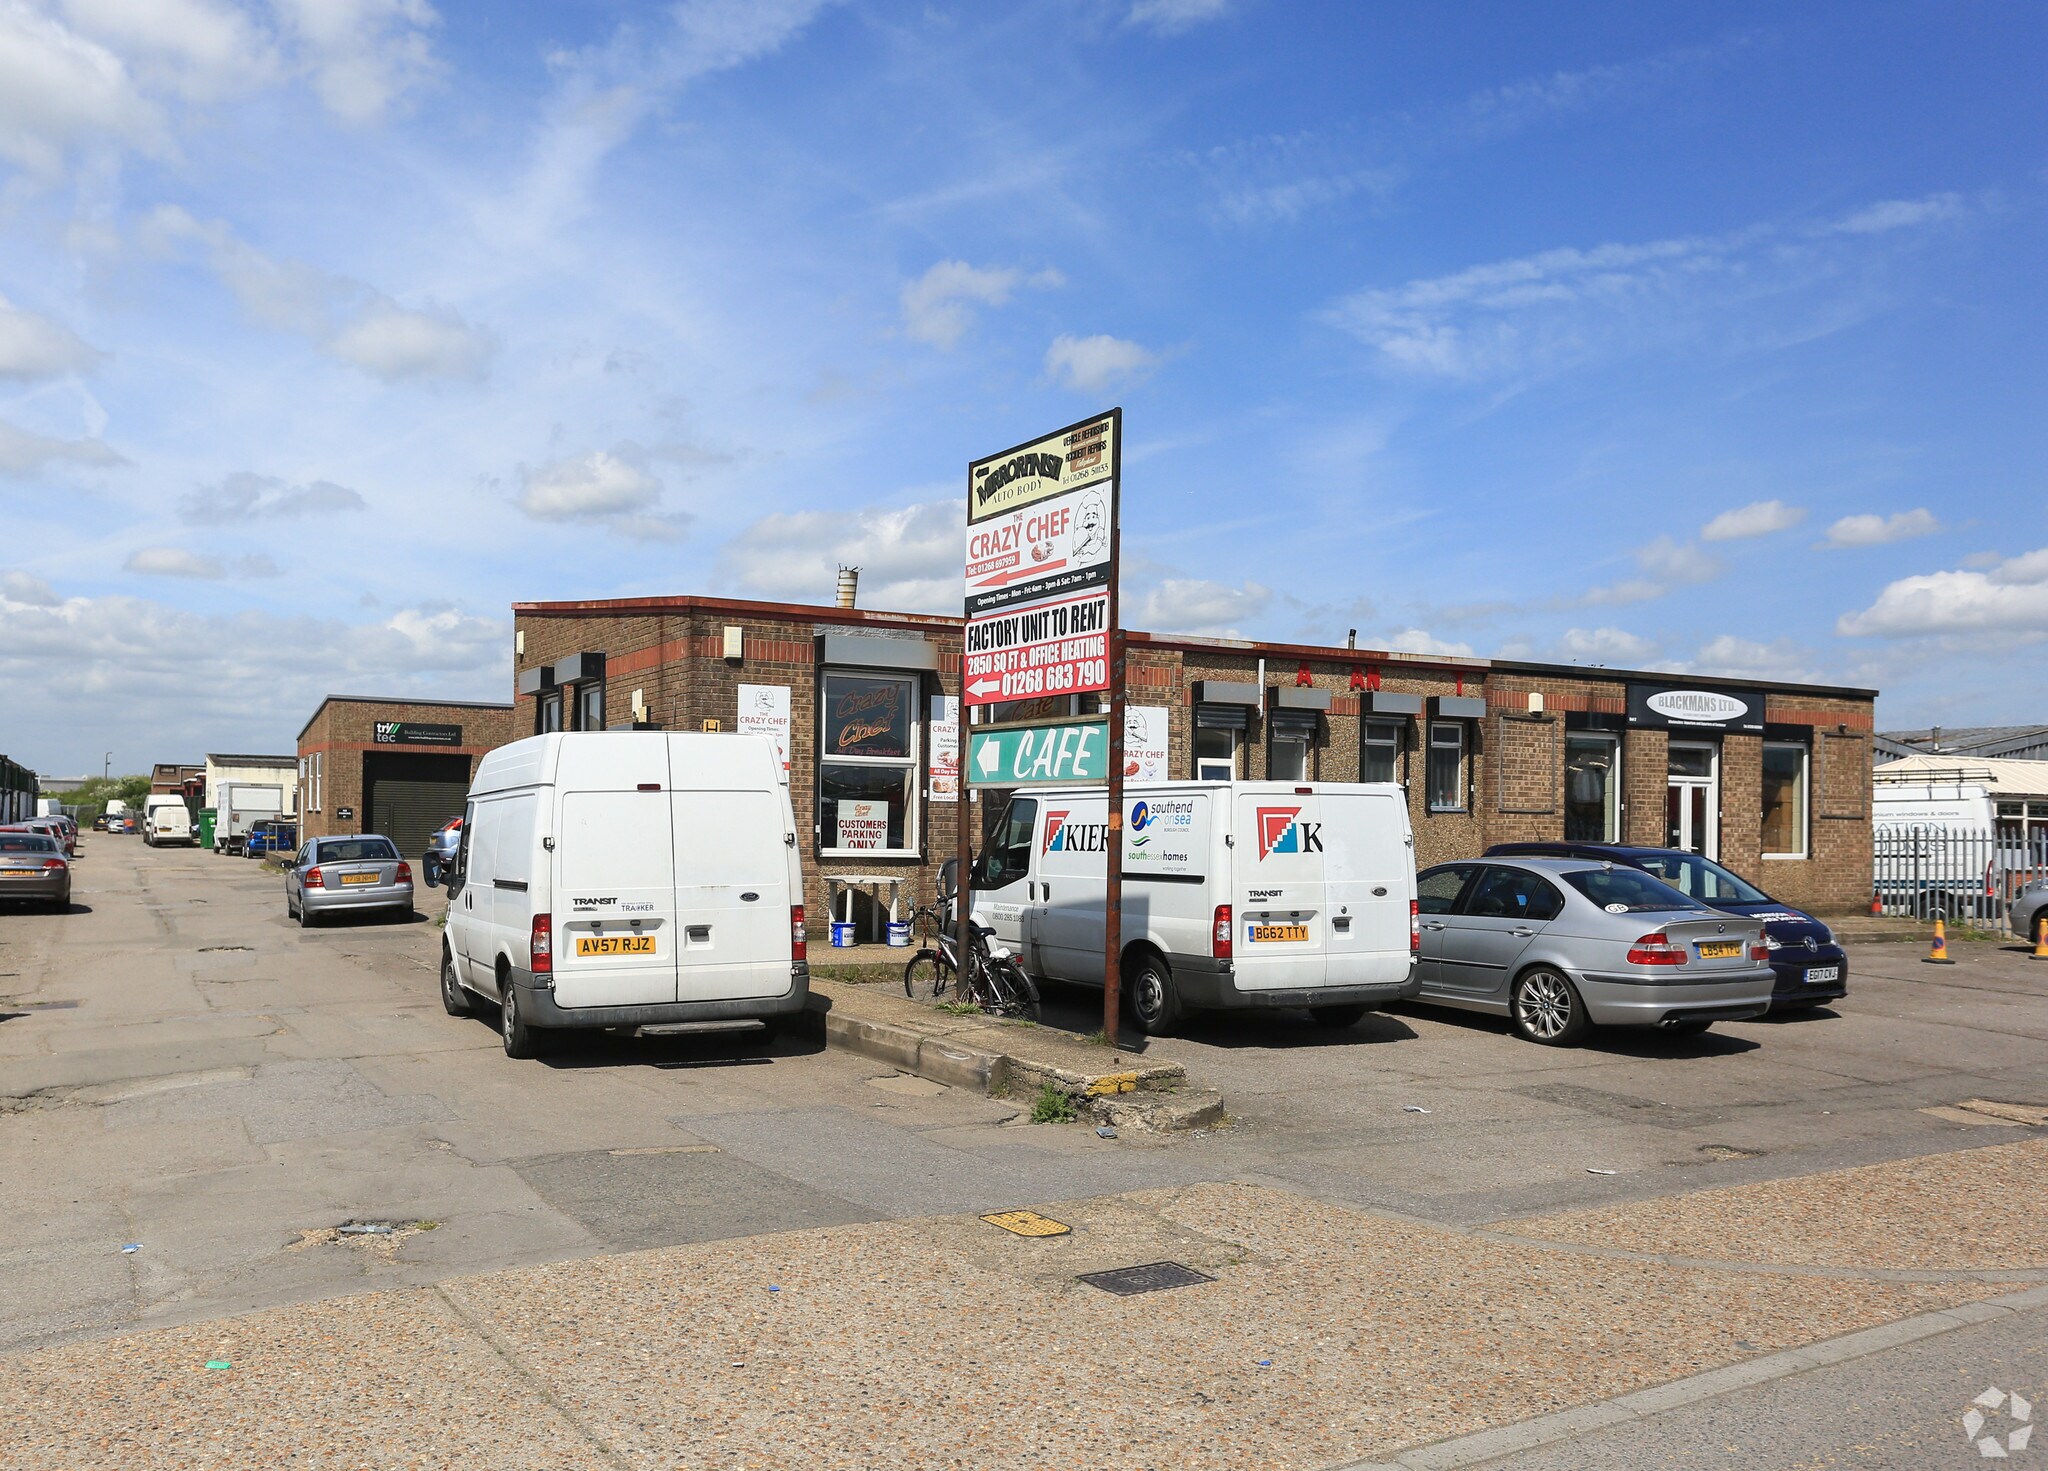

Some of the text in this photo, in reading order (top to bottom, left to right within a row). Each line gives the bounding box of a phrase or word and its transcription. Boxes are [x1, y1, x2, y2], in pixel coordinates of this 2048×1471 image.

[992, 479, 1042, 504] AUTO BODY
[1013, 512, 1023, 522] THE
[970, 507, 1070, 559] CRAZY CHEF
[978, 561, 994, 573] 01268
[977, 596, 996, 606] Opening
[996, 593, 1009, 601] Times
[1032, 584, 1042, 592] 6am
[1045, 581, 1056, 590] 3pm
[1071, 575, 1082, 583] 7am
[1085, 571, 1096, 580] 1pm
[968, 599, 1106, 652] FACTORY UNIT TO RENT
[967, 635, 1105, 676] 2850 SQ FT & OFFICE HEATING
[1001, 658, 1106, 697] 01268 683 790
[836, 683, 900, 718] Crazy
[1658, 695, 1737, 712] BLACKMANS LTD.
[740, 716, 788, 725] CRAZY CHEF
[839, 705, 899, 747] Chef
[932, 725, 956, 733] CRAZY
[377, 733, 396, 743] tec
[1013, 725, 1100, 779] CAFE
[855, 803, 872, 811] Crazy
[1150, 799, 1194, 813] southend
[838, 819, 887, 829] CUSTOMERS
[842, 830, 882, 839] PARKING
[1064, 824, 1109, 852] KIER
[1300, 823, 1323, 853] K
[848, 840, 876, 848] ONLY
[572, 897, 618, 905] TRANSIT
[993, 903, 1019, 912] Maintenance
[1609, 904, 1626, 913] GB
[1256, 926, 1306, 939] BG62 TTY
[582, 937, 650, 953] AV57 RJZ
[1701, 943, 1723, 956] LB54
